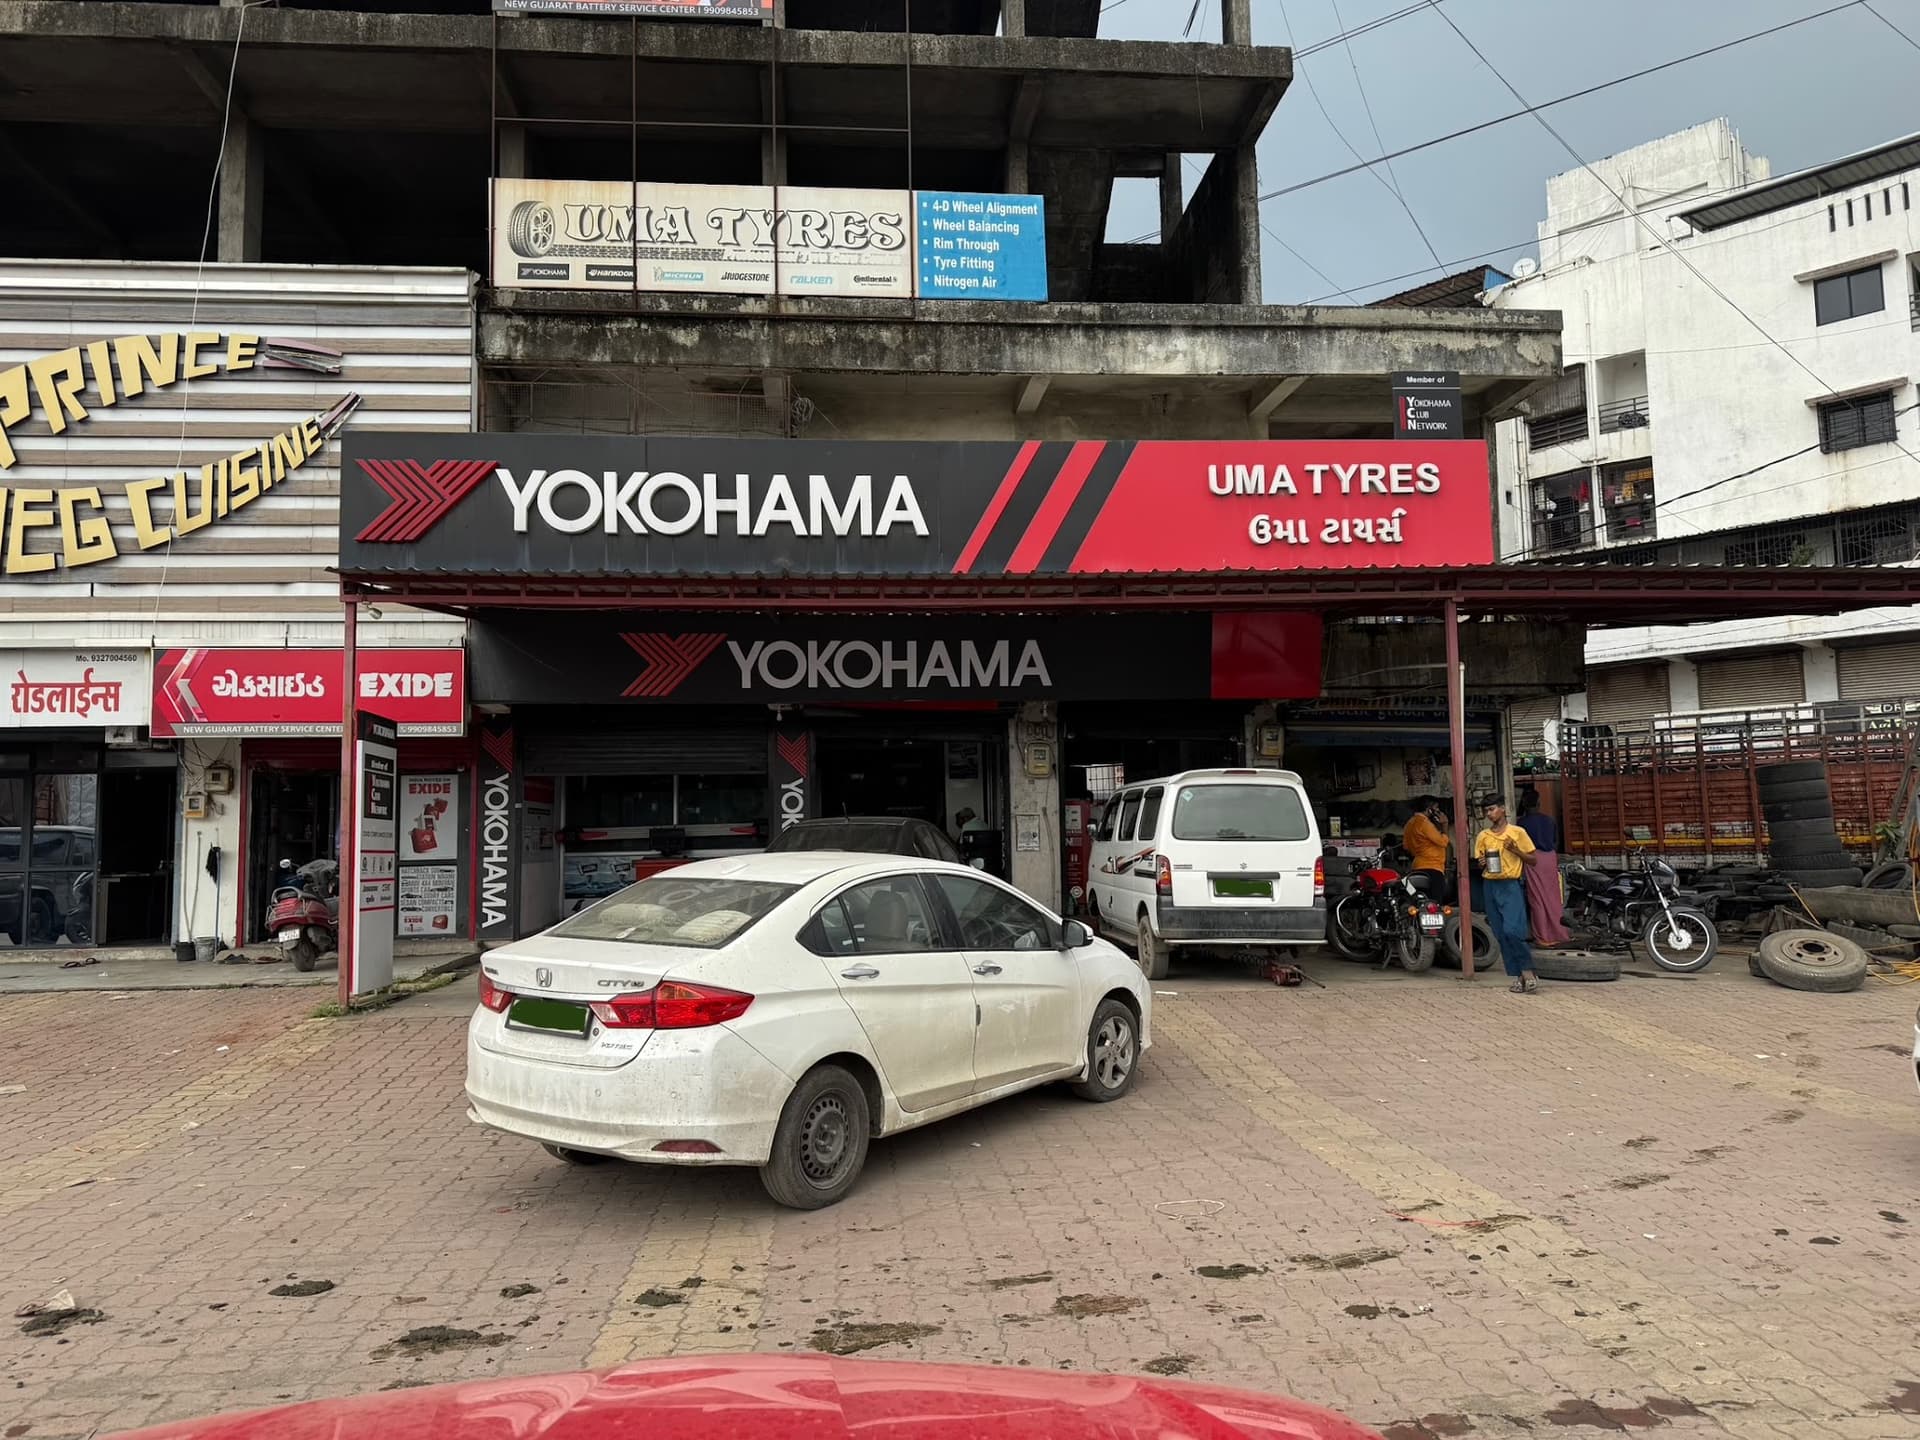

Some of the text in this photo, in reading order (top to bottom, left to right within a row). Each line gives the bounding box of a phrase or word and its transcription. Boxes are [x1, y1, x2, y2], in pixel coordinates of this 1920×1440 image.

[504, 0, 527, 8] NEW
[530, 1, 573, 9] GUJARAT
[576, 2, 617, 11] BATTERY
[619, 3, 657, 13] SERVICE
[660, 5, 696, 14] CENTER
[703, 6, 759, 16] 9909845853
[932, 200, 1038, 216] 4-D Wheel Alignment
[563, 204, 906, 250] UMA TYRES
[932, 218, 1020, 235] Wheel Balancing
[933, 237, 1000, 253] Rim Through
[532, 268, 567, 276] YOKOHAMA
[933, 256, 995, 272] Tyre Fitting
[933, 275, 997, 289] Nitrogen Air
[0, 333, 260, 469] PRINCE
[1406, 396, 1451, 407] YOKOHAMA
[1407, 407, 1430, 419] CLUB
[1407, 419, 1448, 430] NETWORK
[1208, 463, 1441, 495] UMA TYRES
[0, 416, 324, 574] EG CUISINE
[494, 468, 930, 537] YOKOHAMA
[1248, 507, 1408, 545] ઉમા ટાયર્સ
[726, 640, 1053, 689] YOKOHAMA
[359, 672, 454, 698] EXIDE
[247, 725, 280, 733] BATTERY
[281, 725, 313, 733] SERVICE
[408, 783, 451, 794] EXIDE
[481, 772, 510, 929] YOKOHAMA
